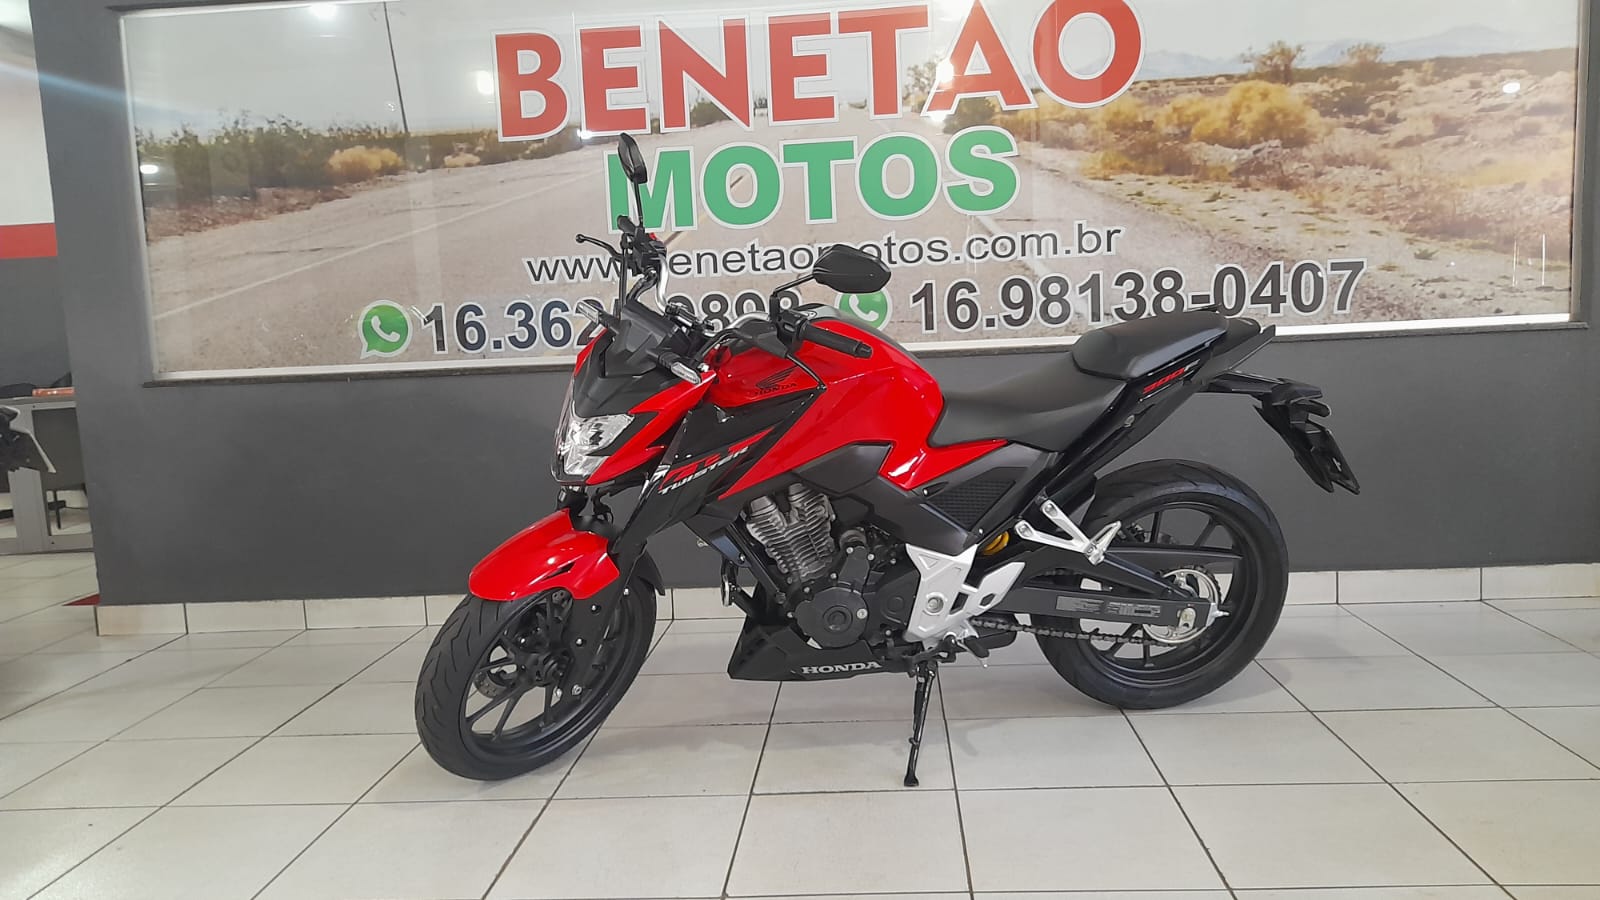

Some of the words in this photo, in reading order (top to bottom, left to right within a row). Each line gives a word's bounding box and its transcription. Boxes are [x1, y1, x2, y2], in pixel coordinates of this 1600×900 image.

[494, 0, 1142, 138] BENETAO
[606, 128, 1017, 231] MOTOS
[527, 223, 1121, 282] wwwenetaootos.com.br
[911, 260, 1366, 331] 16.98138-0407
[658, 446, 749, 495] TWISTER
[801, 661, 882, 674] HONDA
